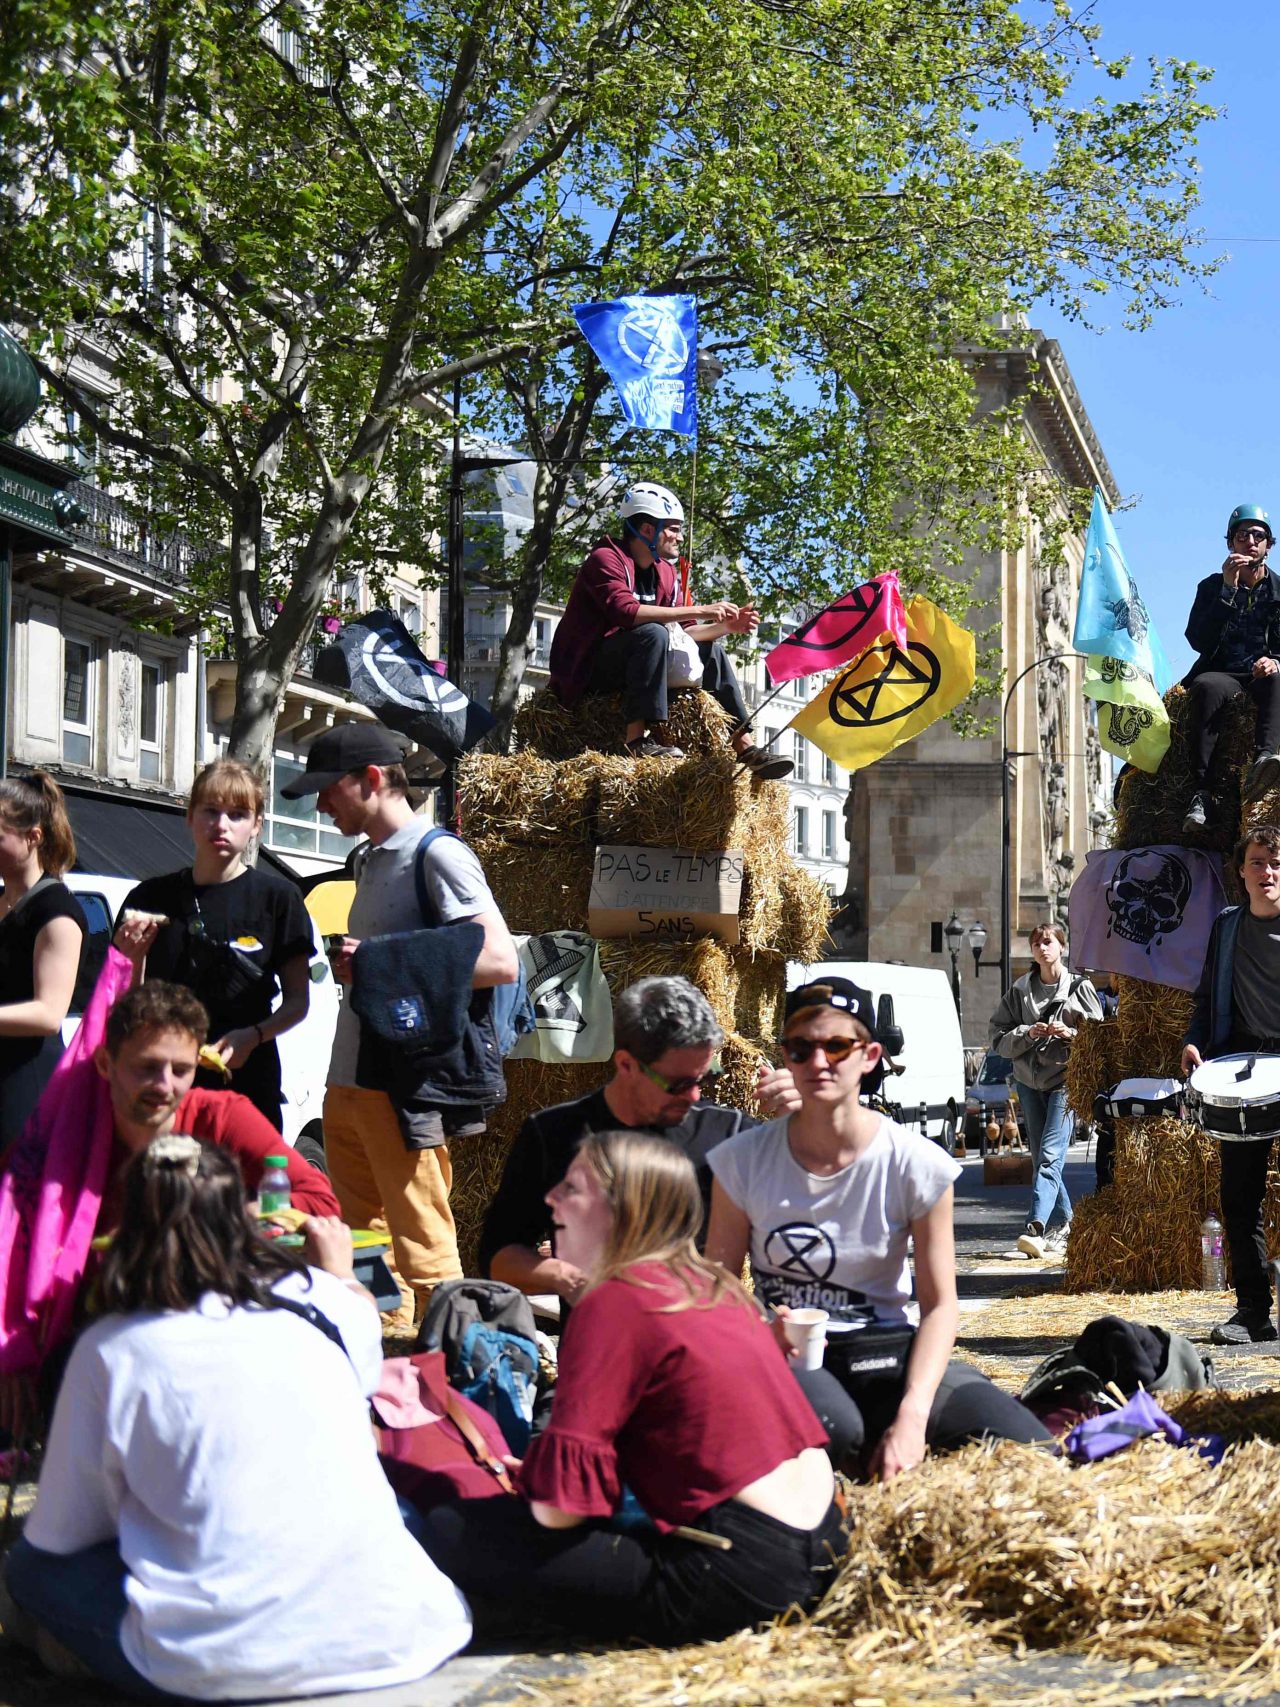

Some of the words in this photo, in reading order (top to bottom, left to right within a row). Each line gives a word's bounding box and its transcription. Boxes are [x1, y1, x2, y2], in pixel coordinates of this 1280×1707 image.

[598, 853, 651, 883] PAS
[655, 869, 670, 883] LE
[671, 855, 744, 884] TEMPS
